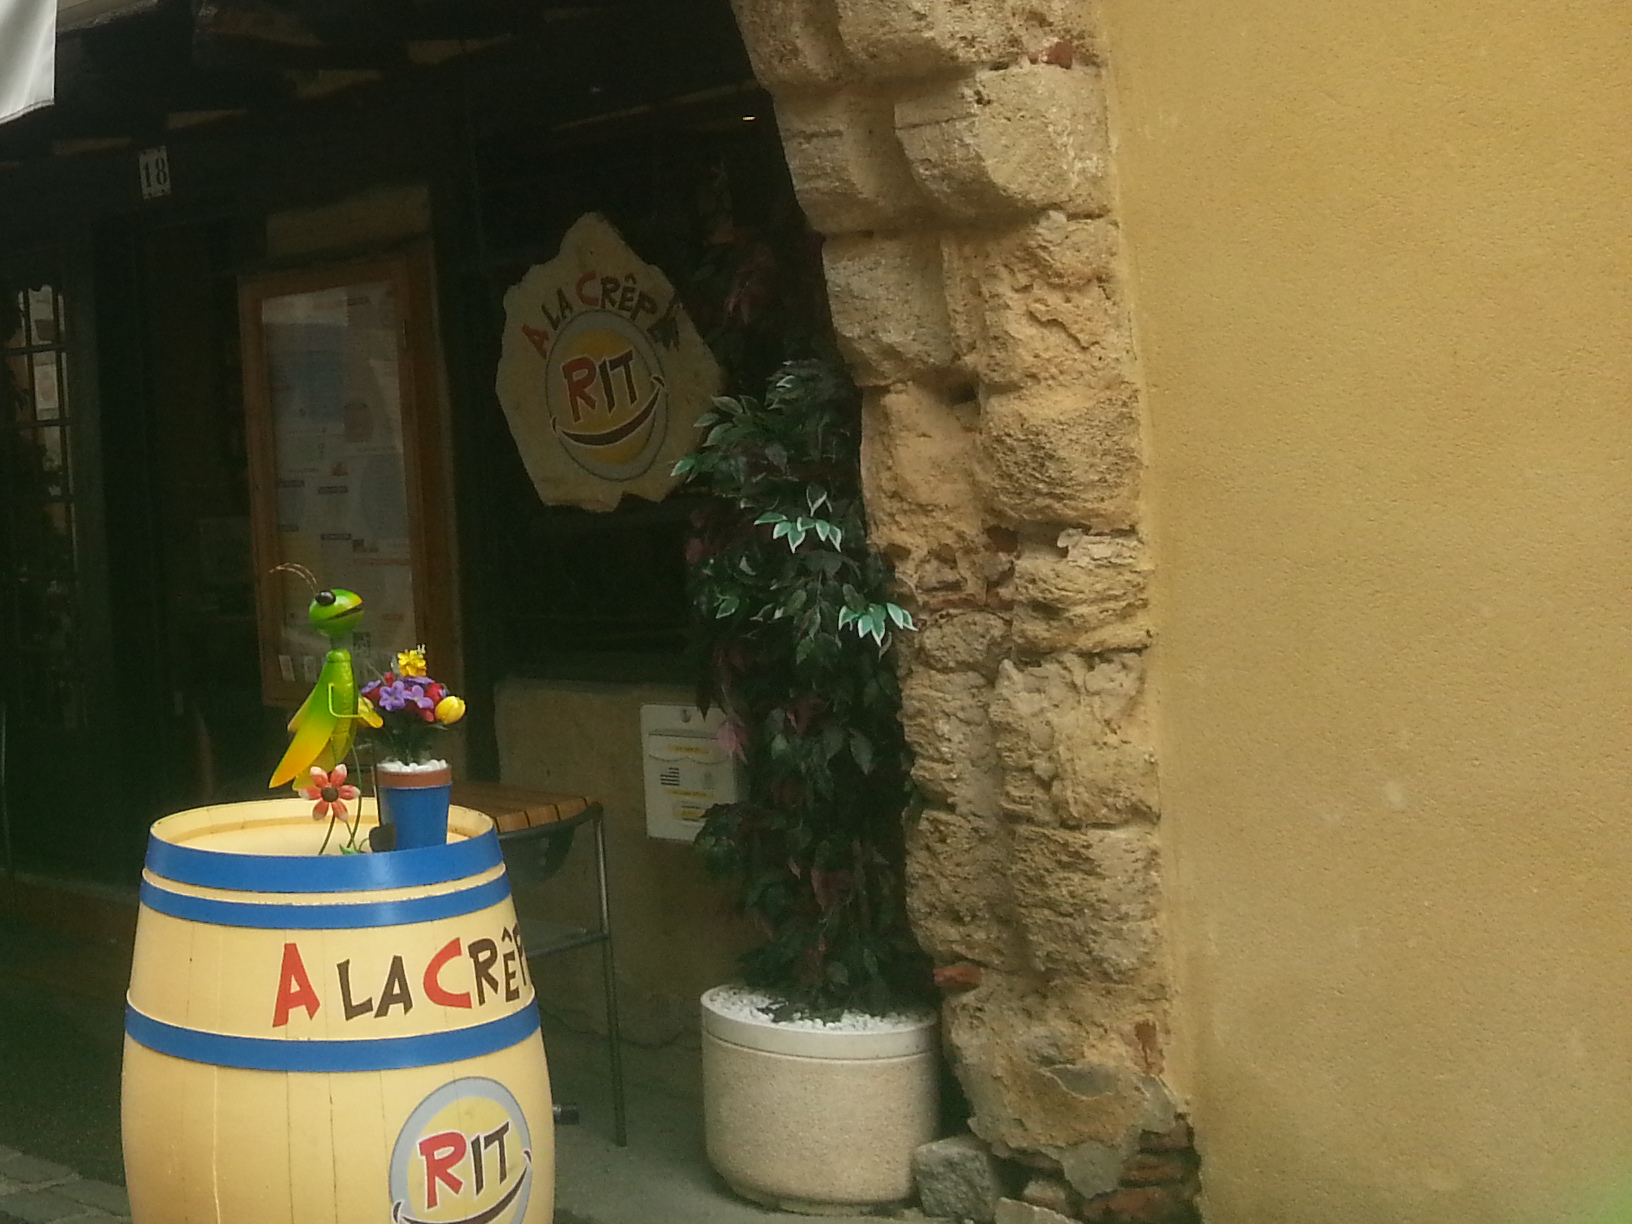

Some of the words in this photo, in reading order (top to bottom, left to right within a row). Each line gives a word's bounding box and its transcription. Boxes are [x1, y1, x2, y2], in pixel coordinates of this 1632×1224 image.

[144, 157, 167, 188] 18
[522, 324, 549, 359] A
[541, 287, 574, 331] LA
[561, 349, 639, 423] RIT
[272, 943, 321, 1028] A
[336, 955, 414, 1021] LA
[418, 1121, 511, 1211] RIT
